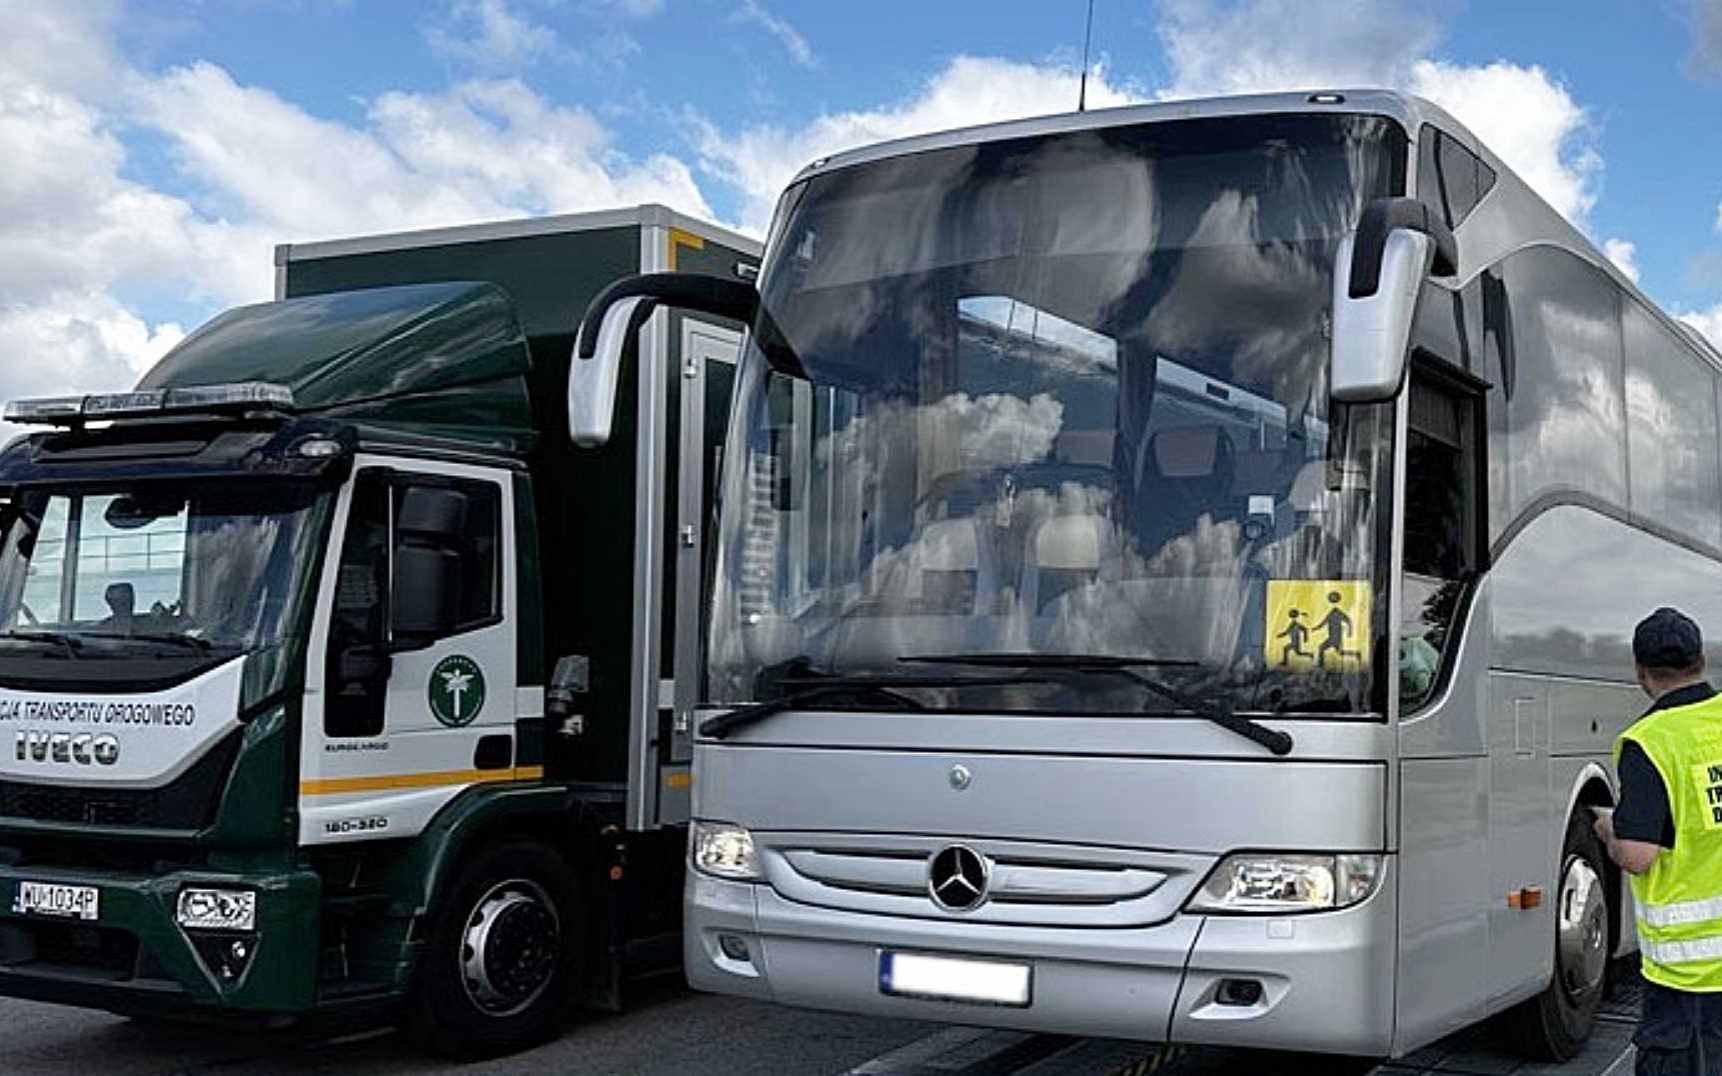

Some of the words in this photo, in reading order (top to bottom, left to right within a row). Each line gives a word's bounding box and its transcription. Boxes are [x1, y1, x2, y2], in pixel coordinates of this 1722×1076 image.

[25, 701, 103, 723] TRANSPORTU
[105, 704, 195, 726] DROGOWEGO
[16, 730, 120, 765] IVECO
